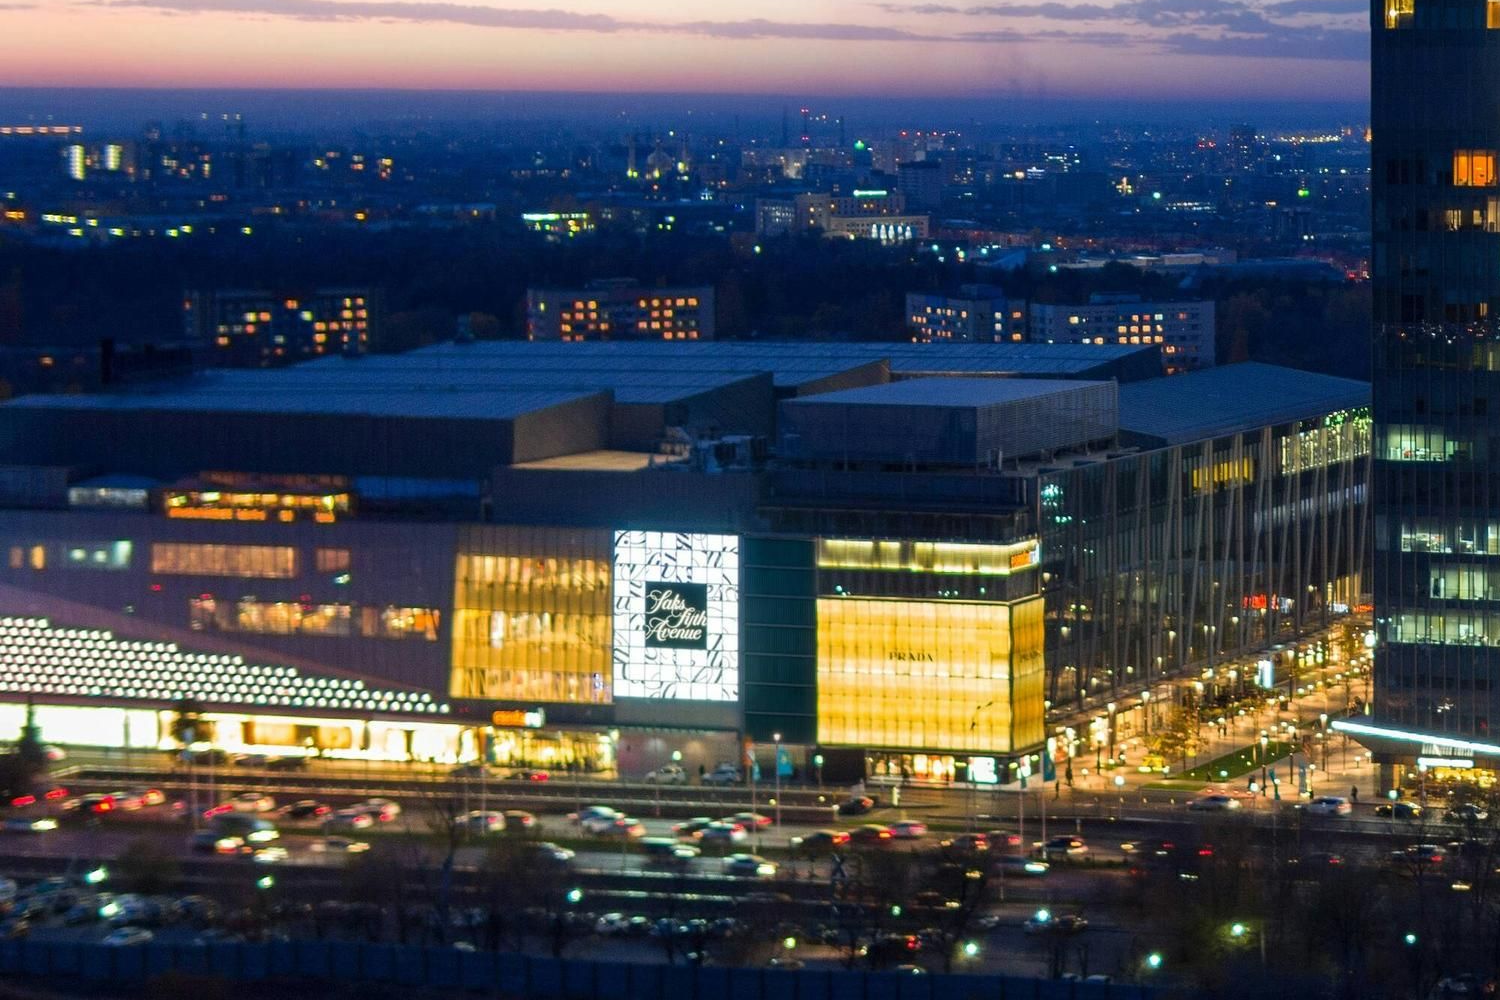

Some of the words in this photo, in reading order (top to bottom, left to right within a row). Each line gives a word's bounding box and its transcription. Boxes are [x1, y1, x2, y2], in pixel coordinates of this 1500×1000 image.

[645, 589, 686, 617] Saks
[666, 607, 708, 628] Fifth
[644, 617, 703, 641] Avenue
[889, 651, 934, 662] PRADA
